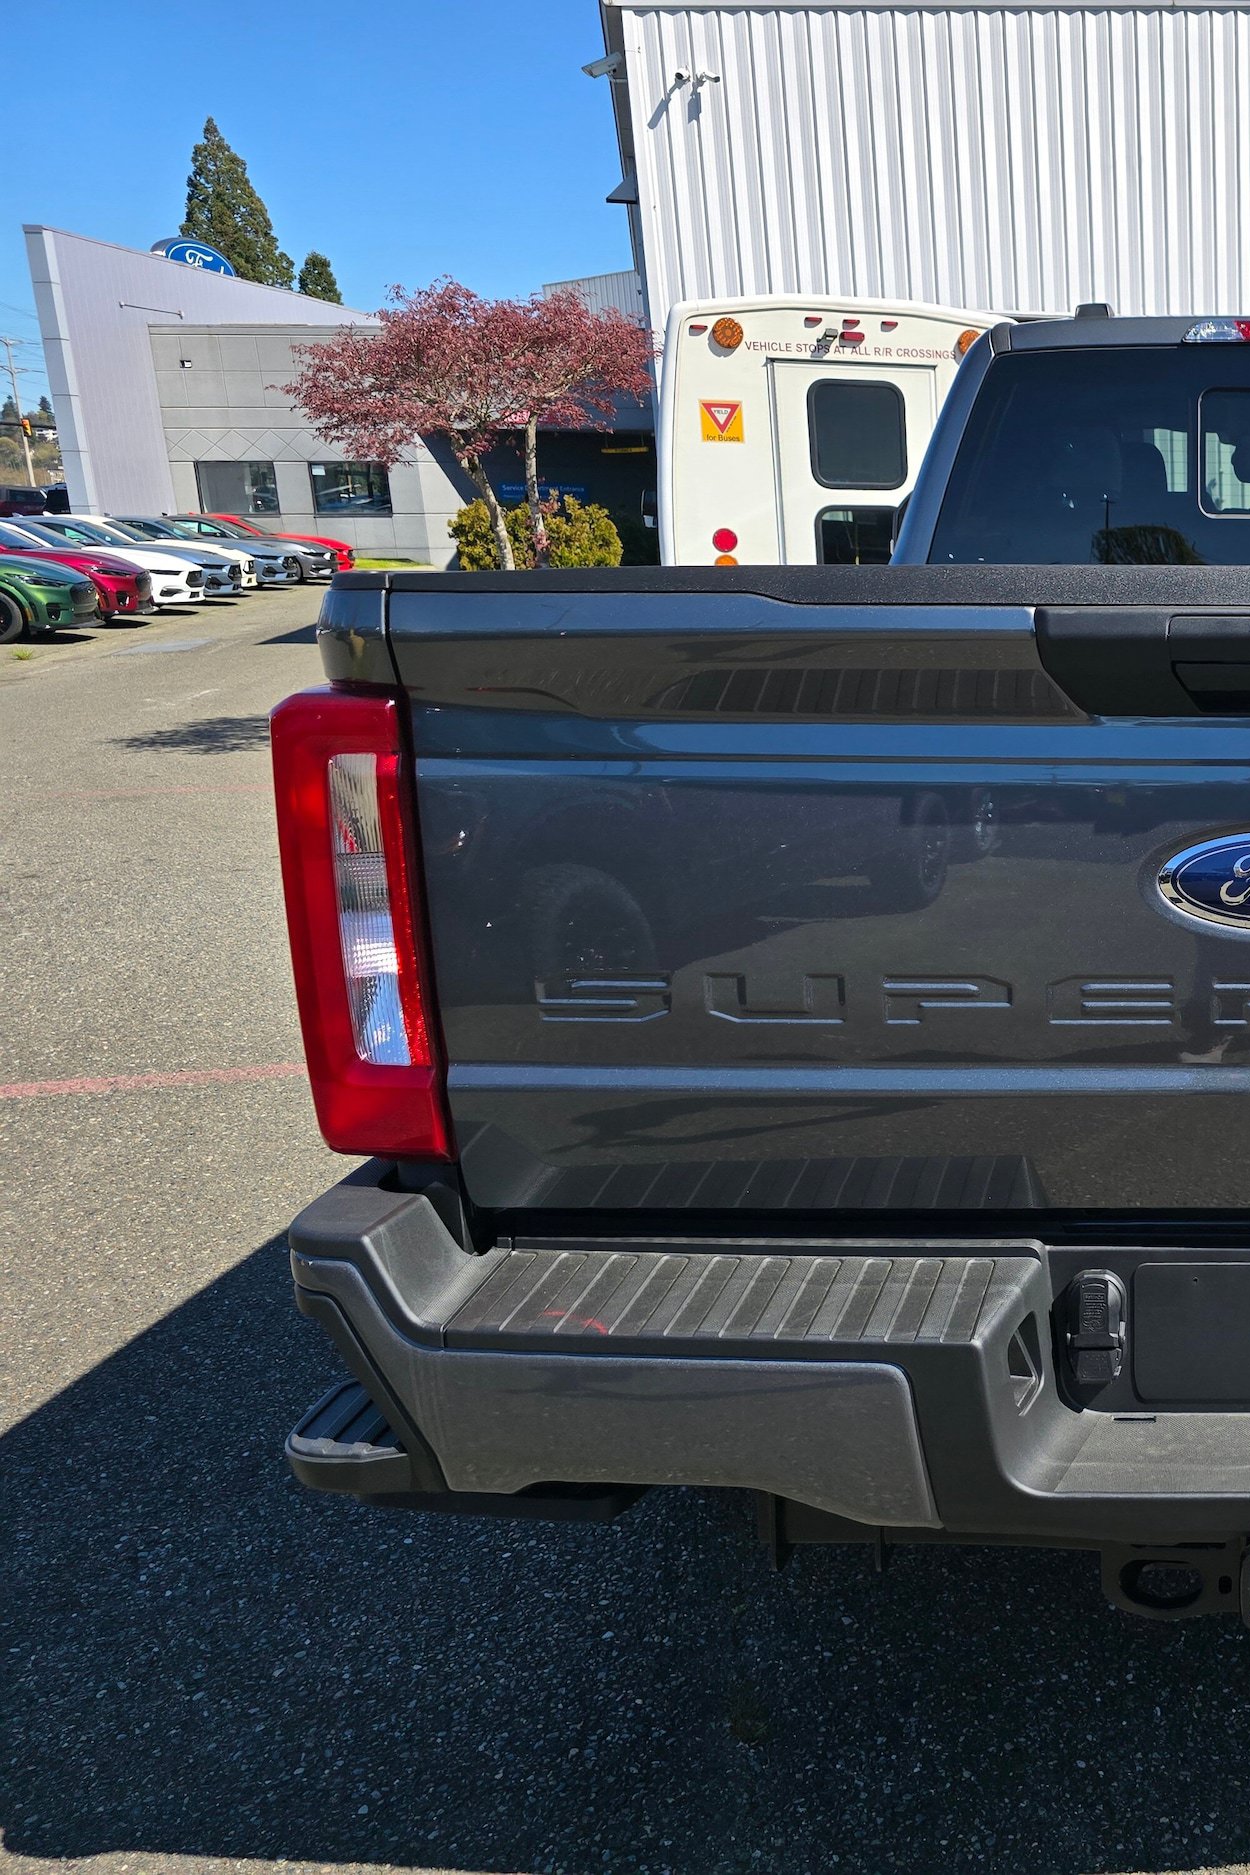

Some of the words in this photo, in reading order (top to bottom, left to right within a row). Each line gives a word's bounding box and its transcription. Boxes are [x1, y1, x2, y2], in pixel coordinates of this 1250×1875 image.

[745, 341, 792, 352] VEHICLE
[796, 343, 830, 354] STOPS
[833, 345, 846, 354] AT
[851, 346, 870, 355] ALL
[874, 347, 893, 357] R/R
[896, 348, 956, 360] CROSSINGS
